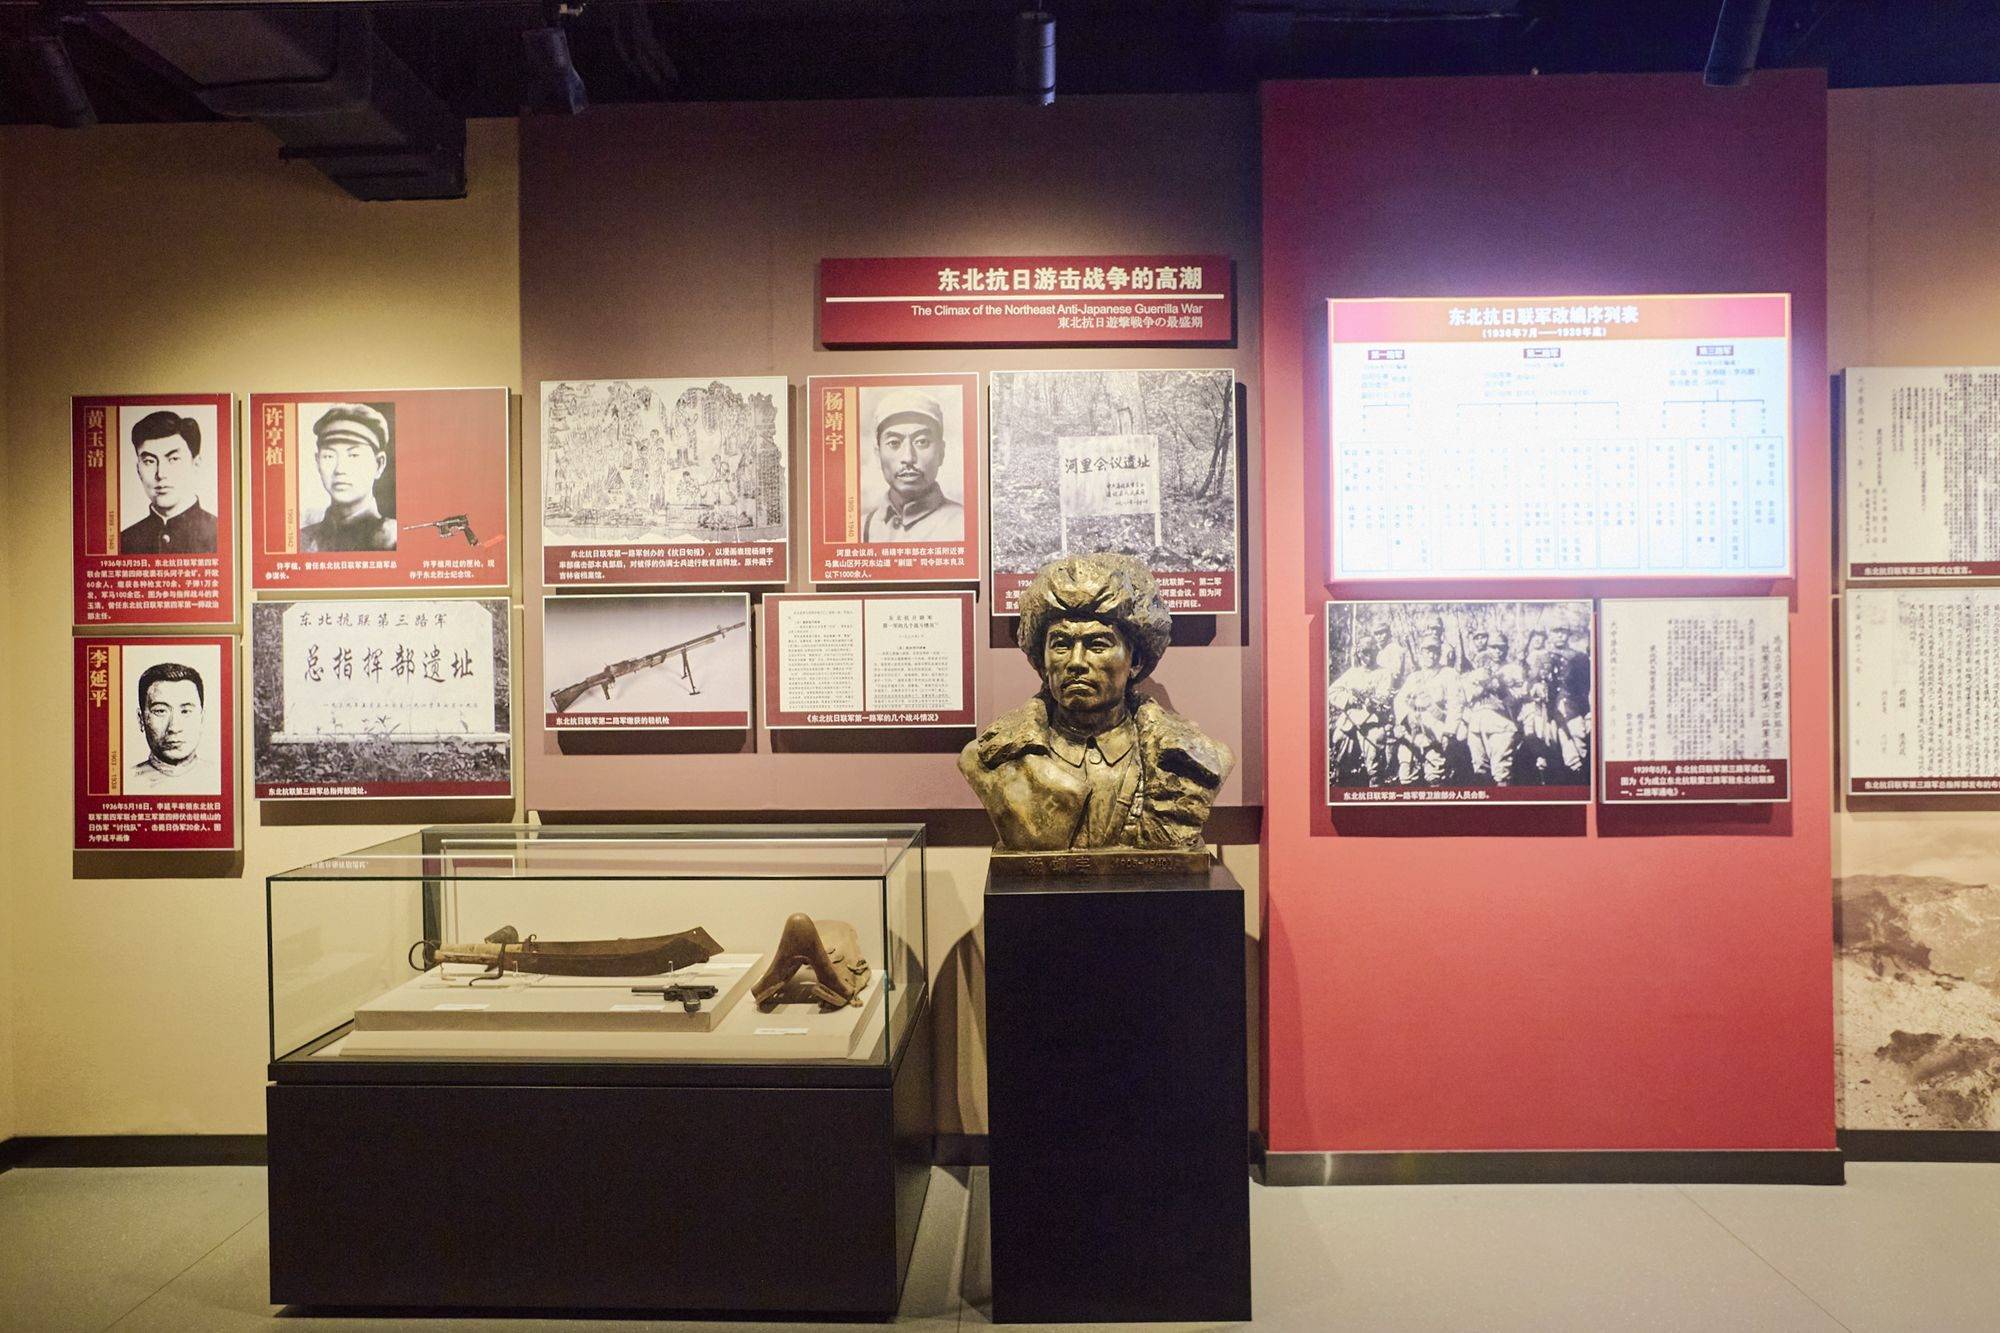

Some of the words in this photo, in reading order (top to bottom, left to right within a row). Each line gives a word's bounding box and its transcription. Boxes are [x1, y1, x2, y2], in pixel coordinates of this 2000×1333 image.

[938, 267, 1203, 291] 东北抗日游击战争的高潮
[912, 305, 932, 316] The
[934, 305, 971, 316] Climax
[973, 305, 983, 315] of
[985, 304, 1002, 315] the
[1004, 304, 1056, 315] Northeast
[1058, 304, 1132, 316] Anti-Japanese
[1134, 304, 1179, 314] Guerrilla
[1181, 304, 1204, 314] War
[1448, 306, 1639, 326] 东北抗日联军改编序列表
[825, 391, 843, 452] 杨靖宇
[87, 410, 104, 467] 黄玉清
[1064, 455, 1150, 474] 河里会议遗址
[300, 612, 447, 628] 东北抗联第三路军
[304, 644, 474, 684] 总指挥部遗址
[90, 649, 108, 708] 李延平
